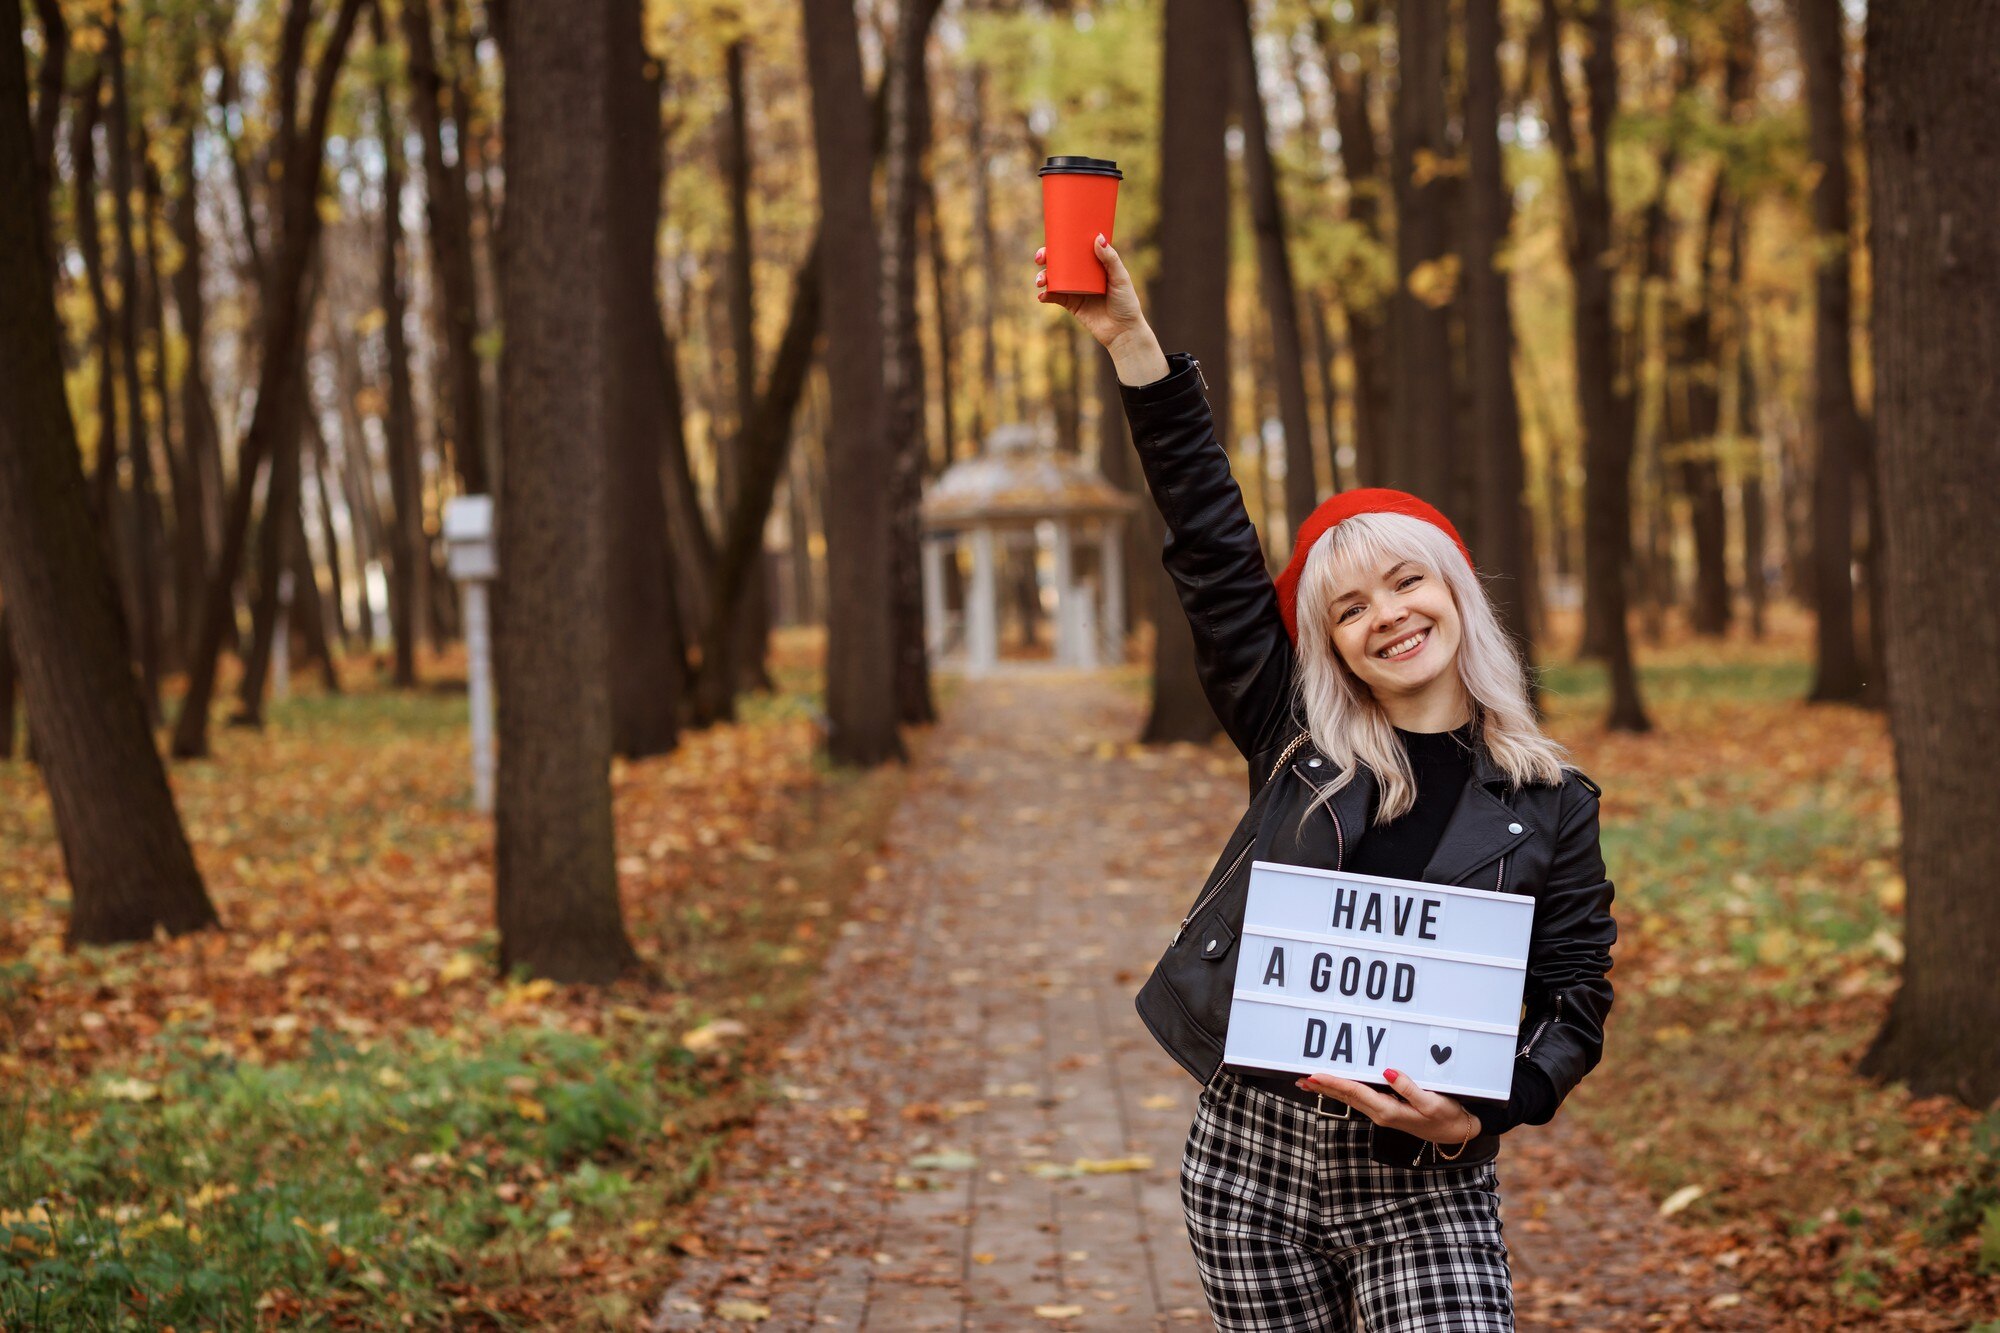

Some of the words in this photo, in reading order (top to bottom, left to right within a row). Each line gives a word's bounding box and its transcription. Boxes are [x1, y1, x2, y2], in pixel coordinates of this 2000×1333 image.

[1331, 888, 1441, 940] HAVE
[1262, 946, 1285, 987] A
[1310, 952, 1416, 1003] GOOD
[1302, 1017, 1387, 1067] DAY
